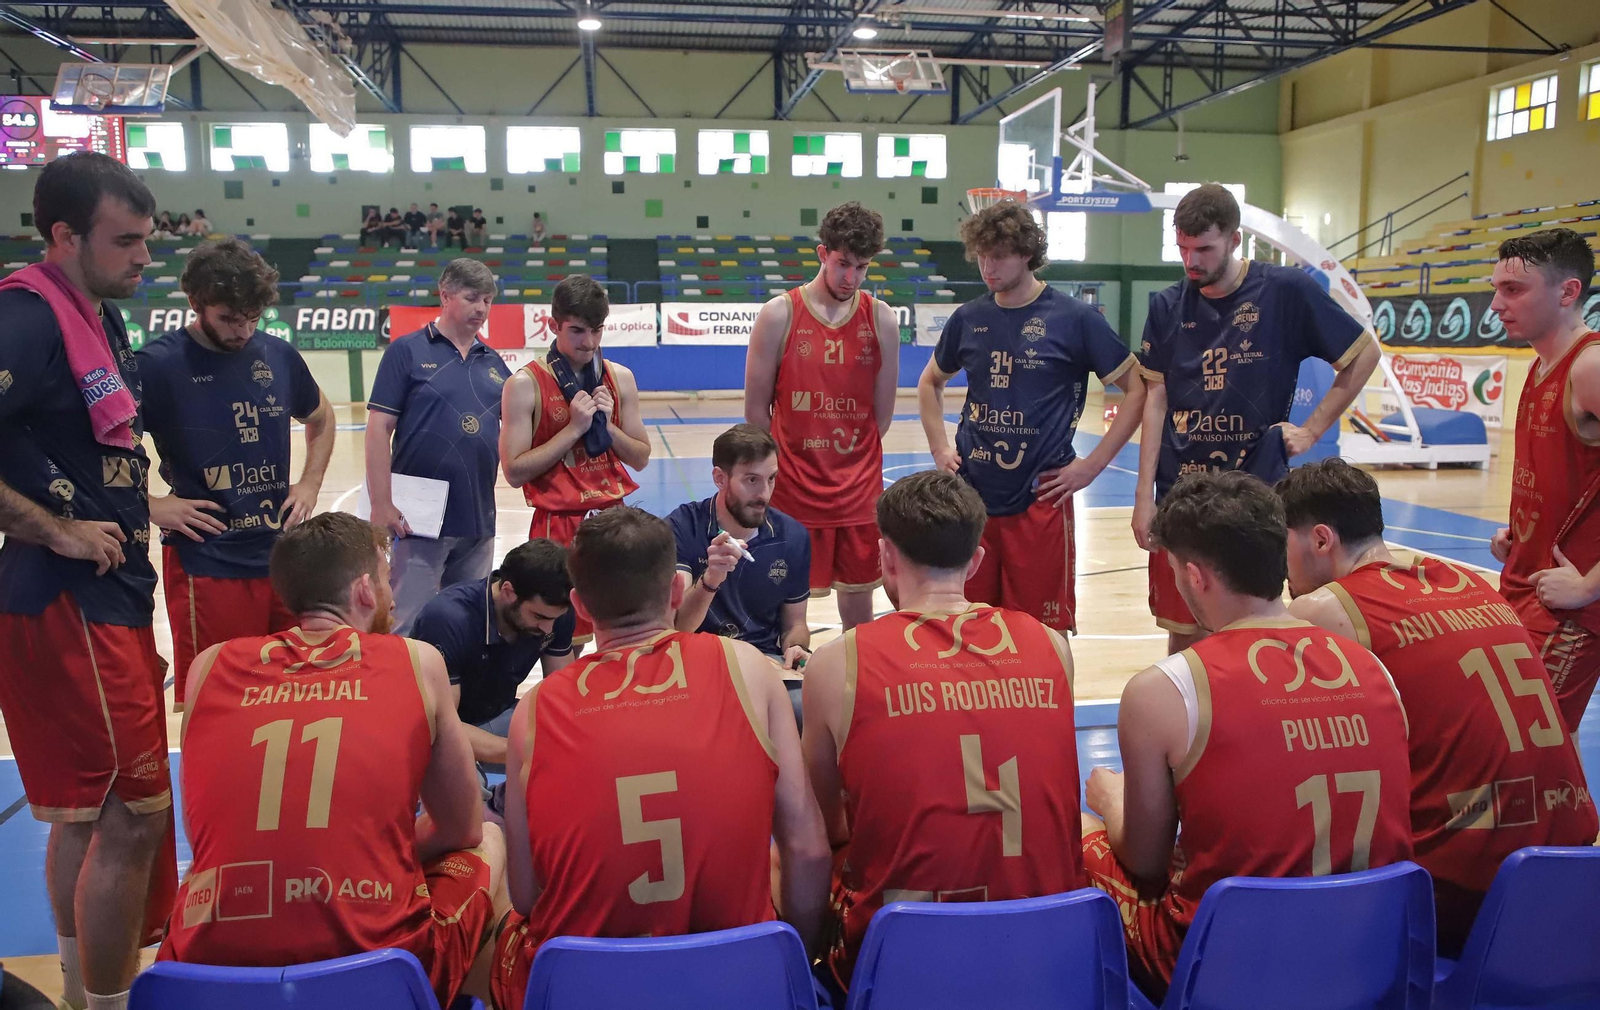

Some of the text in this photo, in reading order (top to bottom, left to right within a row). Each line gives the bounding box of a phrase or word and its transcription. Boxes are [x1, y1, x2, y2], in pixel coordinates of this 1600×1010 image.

[296, 308, 376, 331] FABM
[824, 339, 844, 365] 21
[989, 351, 1013, 374] 34
[1202, 347, 1228, 375] 22
[84, 369, 105, 384] Hero
[232, 401, 260, 428] 24
[813, 391, 857, 412] Jaén
[979, 404, 1024, 426] Jaén
[1189, 408, 1244, 433] Jaén
[803, 435, 830, 450] jaén
[1043, 601, 1060, 616] 34
[1390, 612, 1444, 648] JAVI
[940, 661, 950, 669] de
[240, 679, 368, 707] CARVAJAL
[884, 677, 1058, 717] LUIS RODRIGUEZ
[1458, 642, 1565, 752] 15
[603, 703, 614, 711] de
[1281, 713, 1370, 752] PULIDO
[250, 716, 343, 831] 11
[959, 734, 1023, 857] 4
[1295, 770, 1381, 877] 17
[615, 770, 685, 905] 5
[285, 877, 393, 903] RK ACM
